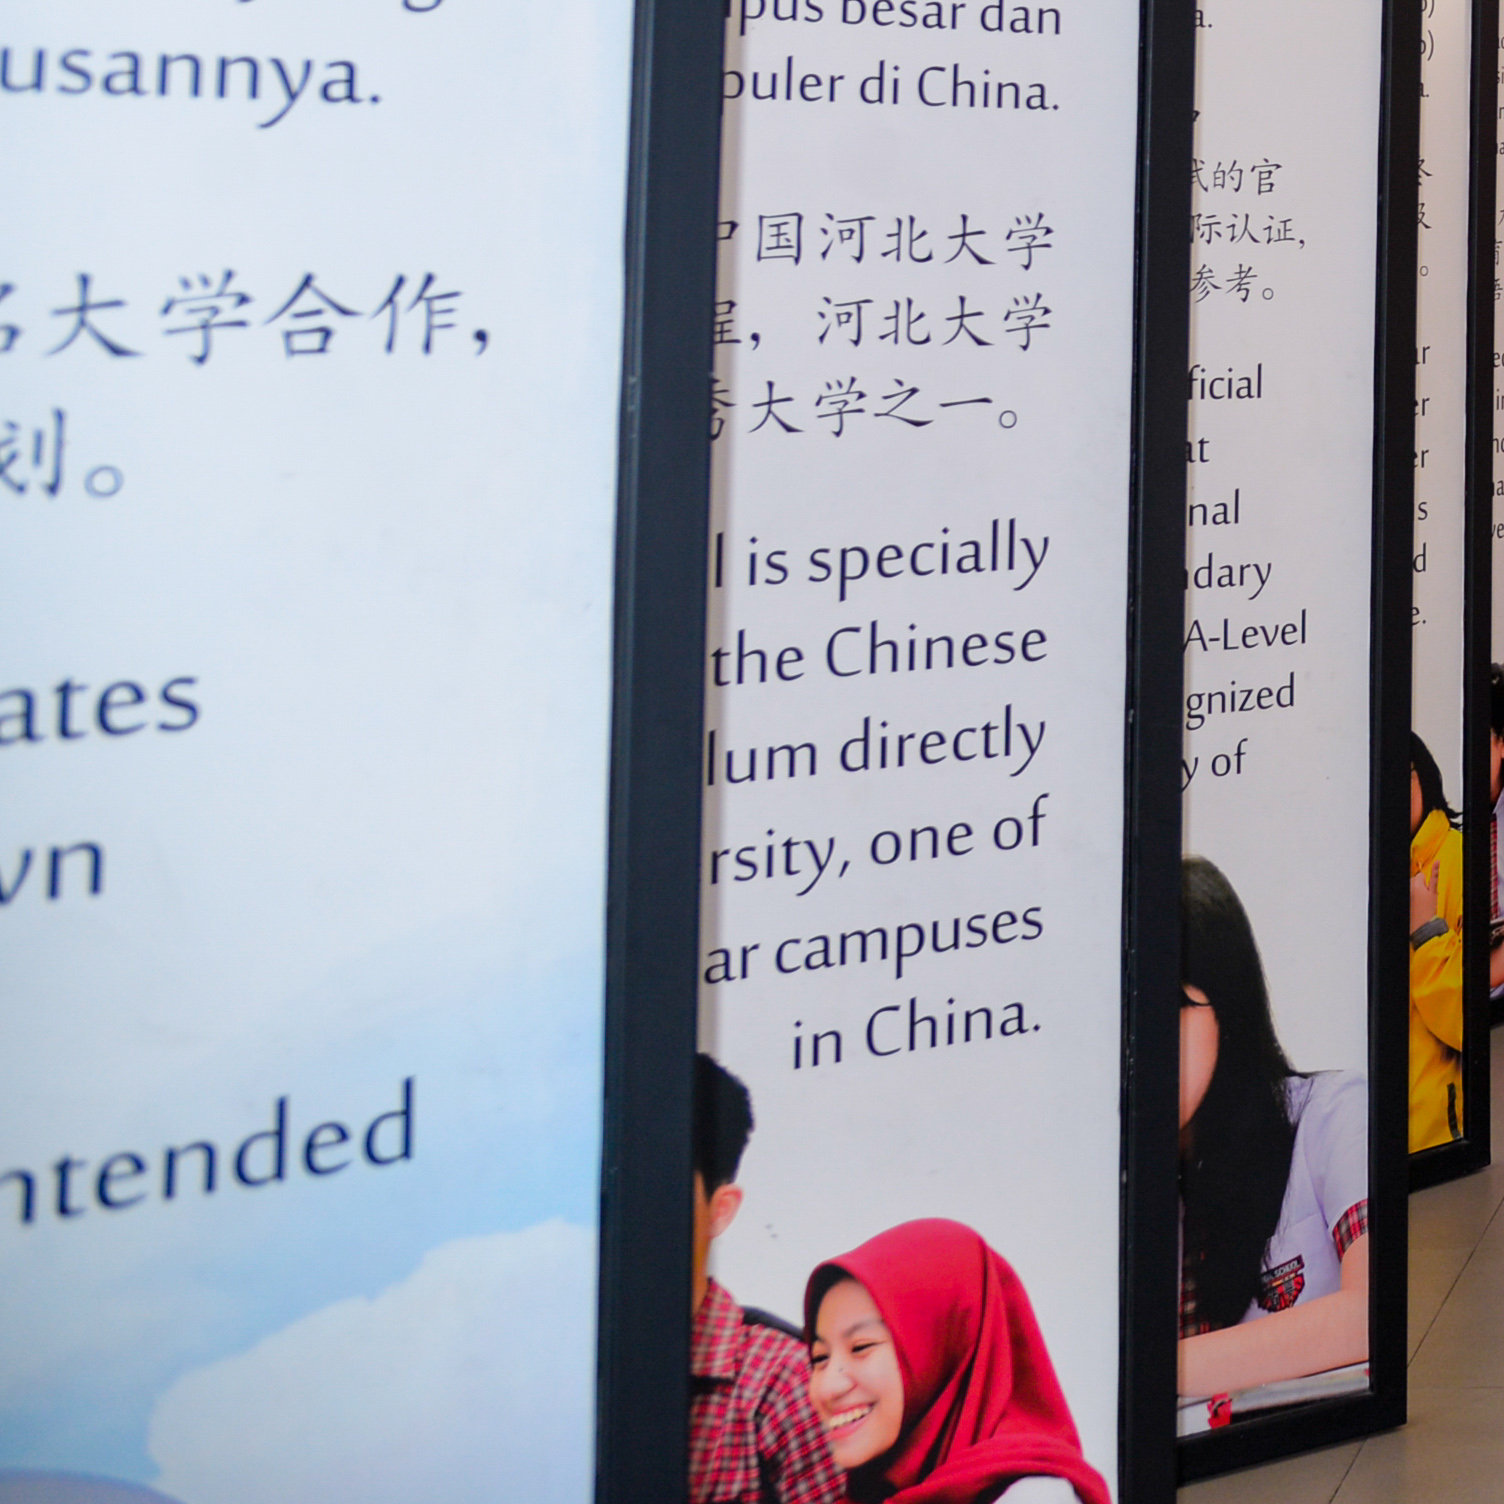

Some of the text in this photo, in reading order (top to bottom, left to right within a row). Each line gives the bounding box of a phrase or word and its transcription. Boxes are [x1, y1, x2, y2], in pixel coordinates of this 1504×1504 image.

[859, 60, 902, 106] di
[917, 64, 1061, 112] China.
[1188, 488, 1240, 527] nal
[747, 536, 789, 587] is
[807, 517, 1050, 602] specially
[1184, 552, 1272, 600] dary
[711, 620, 1048, 687] the Chinese
[1183, 608, 1307, 655] A-Level
[1185, 672, 1296, 731] gnized
[705, 704, 1046, 786] lum directly
[1210, 740, 1247, 778] of
[710, 793, 1050, 896] rsity, one of
[703, 905, 1044, 985] ar campuses
[793, 996, 1042, 1070] in China.
